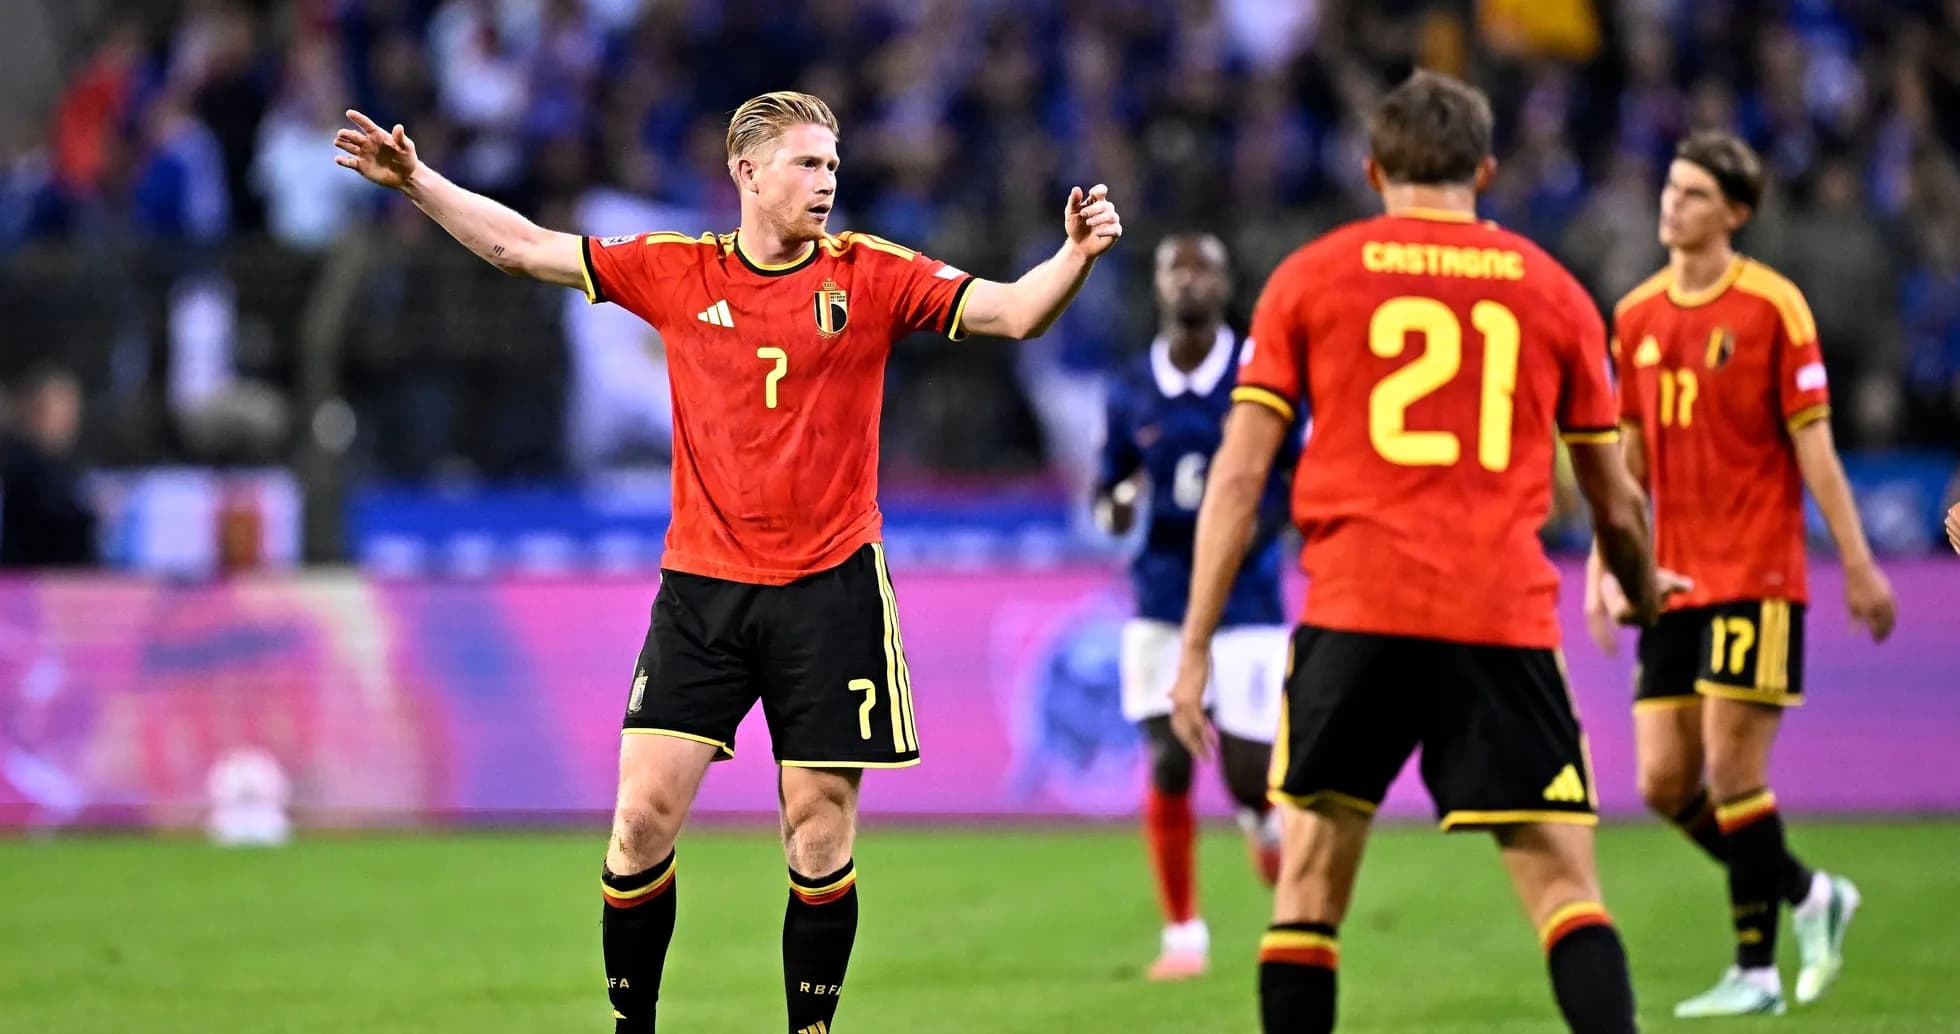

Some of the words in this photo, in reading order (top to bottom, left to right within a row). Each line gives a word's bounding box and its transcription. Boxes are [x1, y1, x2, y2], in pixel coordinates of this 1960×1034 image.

[1362, 240, 1526, 281] CASTAGNE
[757, 347, 788, 409] 7
[1368, 296, 1521, 472] 21
[1660, 368, 1698, 428] 17
[1711, 616, 1755, 676] 17
[848, 678, 876, 740] 7
